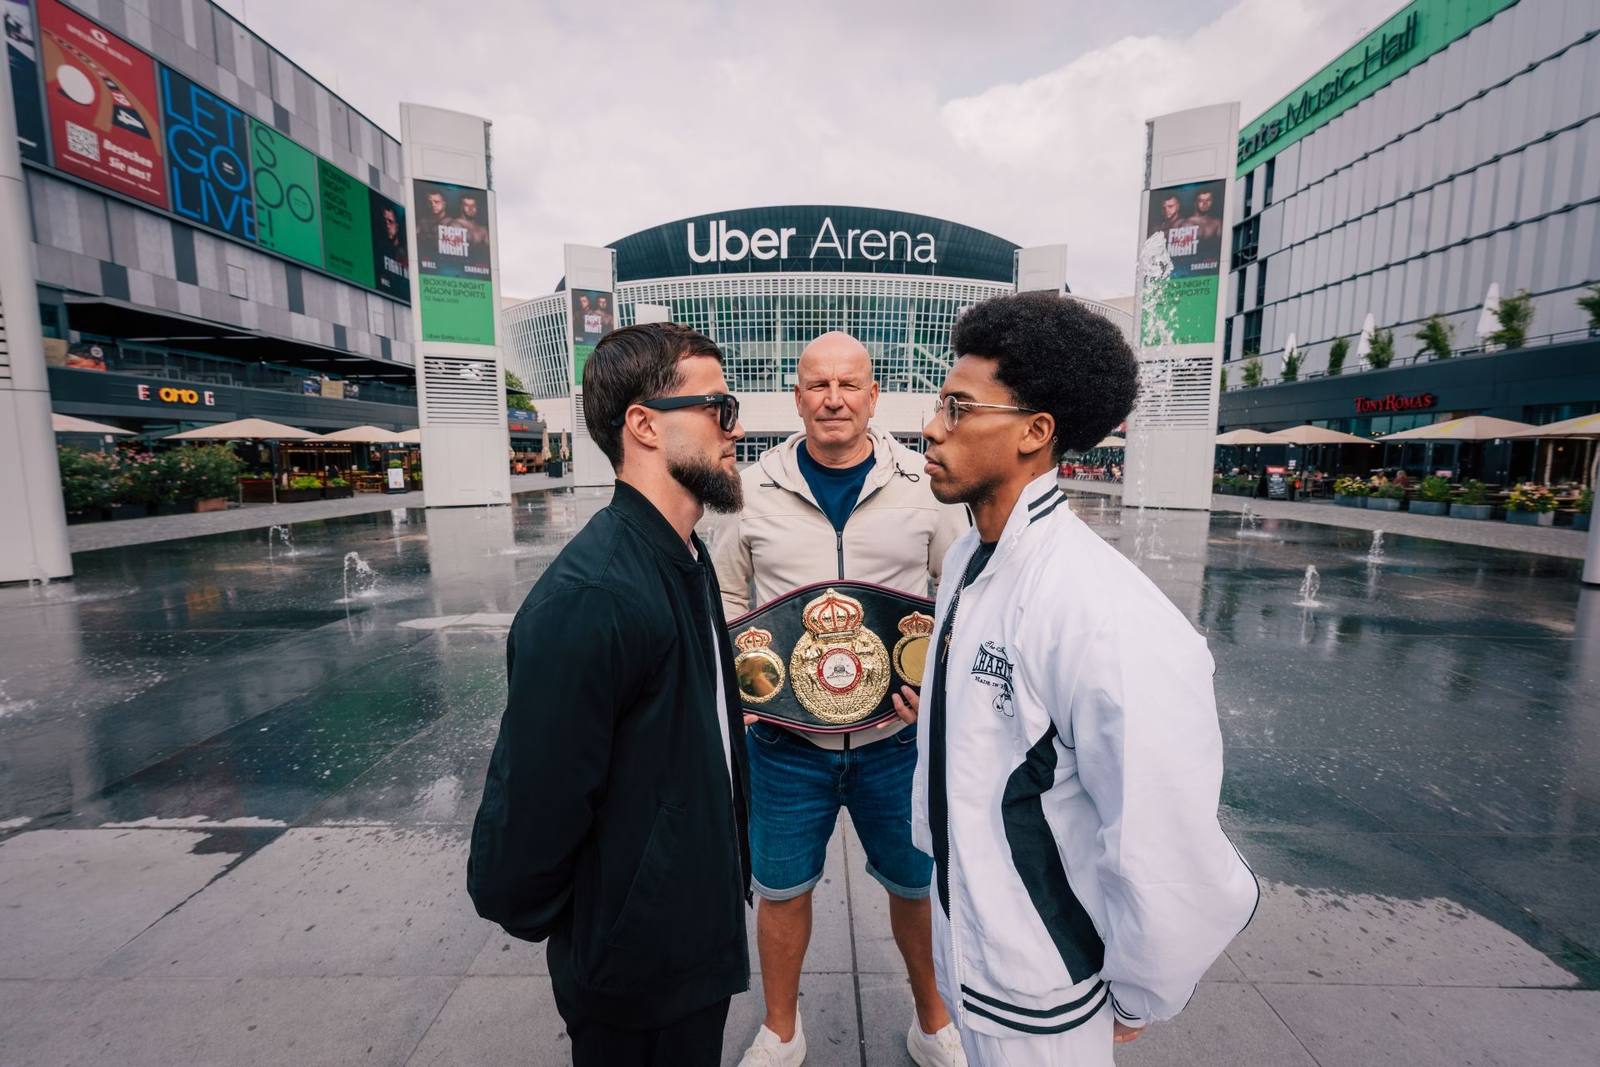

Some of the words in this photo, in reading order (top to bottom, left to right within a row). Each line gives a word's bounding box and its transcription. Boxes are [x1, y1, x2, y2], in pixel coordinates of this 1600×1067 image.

[1286, 66, 1356, 133] Music
[1363, 10, 1419, 79] Hall
[686, 219, 796, 264] Uber
[808, 216, 938, 265] Arena
